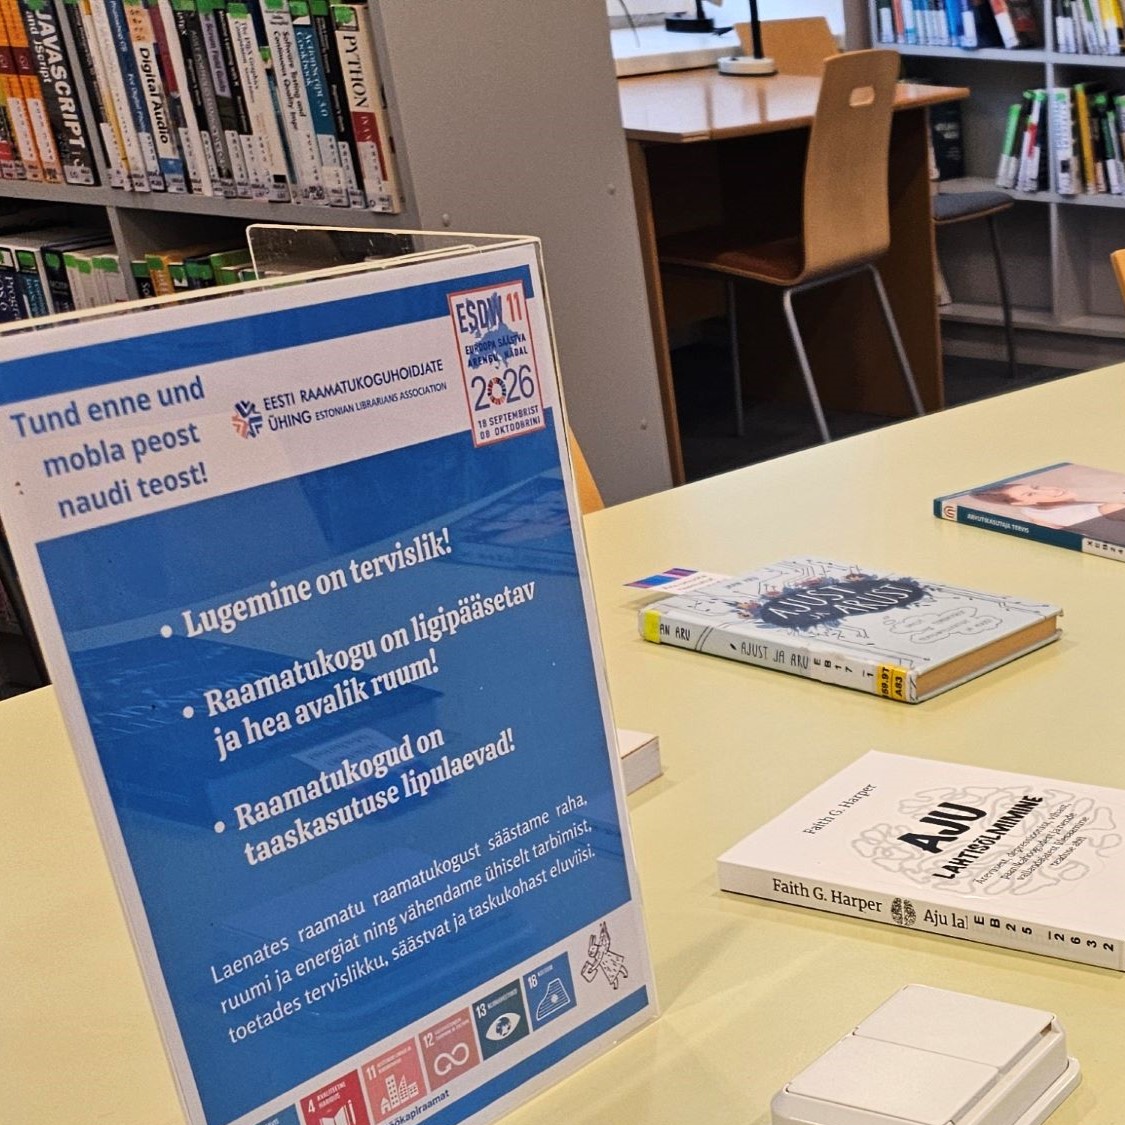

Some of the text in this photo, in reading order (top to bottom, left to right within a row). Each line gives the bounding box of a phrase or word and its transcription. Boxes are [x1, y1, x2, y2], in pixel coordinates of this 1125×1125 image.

[36, 10, 86, 149] JAVASCRIPT
[140, 47, 168, 144] Digital Audio
[343, 35, 370, 108] PYTHON
[506, 292, 522, 322] 11
[465, 340, 496, 355] EUROOPA
[10, 375, 206, 437] Tund enne und
[264, 359, 444, 411] EESTI RAAMATUKOGUHOIDJATE
[268, 382, 448, 432] ÜHING ESTONIAN LIBRARIANS ASSOCIATION
[471, 365, 534, 411] 2026
[478, 405, 539, 429] 18 SEPTEMBRIST
[494, 417, 541, 436] OKTOOBRINI
[43, 423, 200, 478] mobla peost
[58, 462, 208, 518] naudi teost!
[181, 528, 455, 639] Lugemine on tervislik!
[769, 585, 856, 619] AJUST
[834, 584, 913, 614] ARUST
[205, 580, 538, 718] Raamatukogu on ligipääsetav
[676, 627, 691, 641] ARU
[740, 642, 768, 661] AJUST
[773, 650, 786, 664] JA
[213, 649, 442, 761] ja hea avalik ruum!
[233, 728, 445, 831] Raamatukogud on
[242, 728, 518, 866] taaskasutuse lipulaevad!
[804, 782, 878, 836] Faith G. Harper
[898, 802, 987, 855] AJU
[932, 795, 1044, 880] LAHTISÕLMIMINE
[210, 794, 589, 984] Laenates raamatu raamatukogust säästame raha,
[772, 877, 948, 930] Faith G. Harper Aju
[220, 819, 594, 1014] ruumi ja energiat ning vähendame ühiselt tarbimist,
[228, 844, 596, 1044] toetades tervislikku, säästvat ja taskukohast eluviisi.
[528, 974, 538, 990] 18
[476, 1003, 487, 1019] 13
[422, 1032, 435, 1048] 12
[366, 1064, 377, 1080] 11
[308, 1098, 316, 1113] 4
